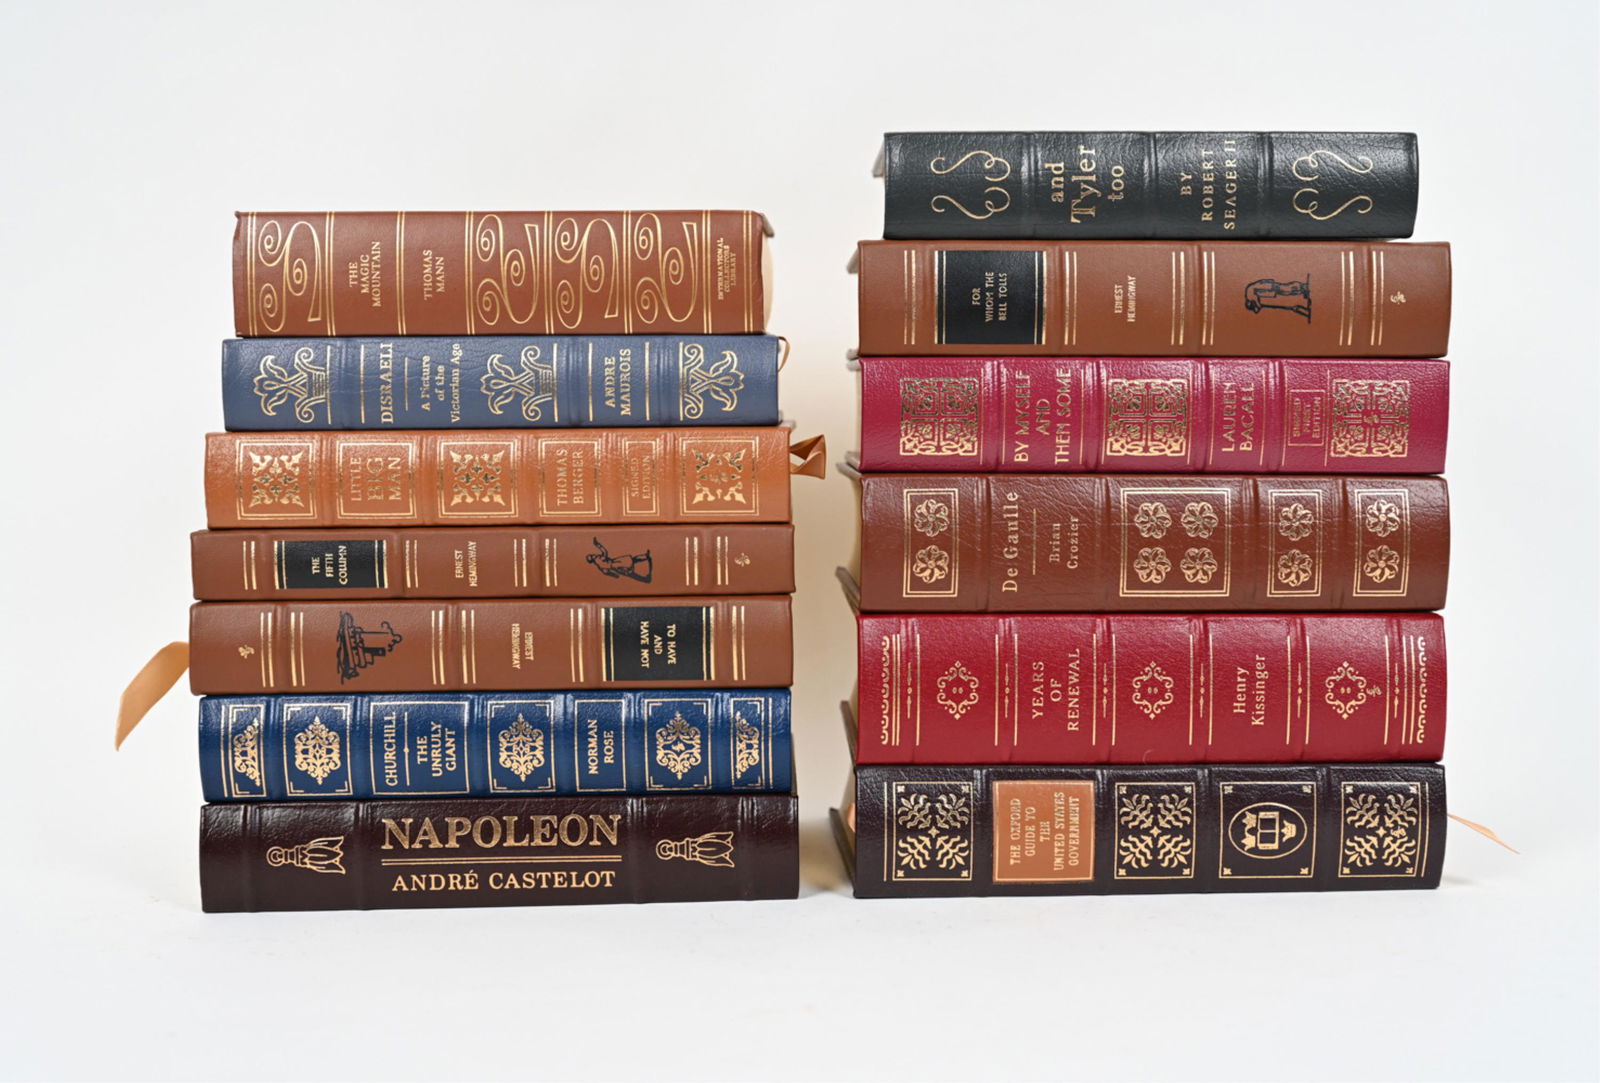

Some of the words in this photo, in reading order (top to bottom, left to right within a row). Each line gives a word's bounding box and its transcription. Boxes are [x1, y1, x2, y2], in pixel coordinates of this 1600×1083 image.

[1224, 139, 1236, 152] II
[1044, 162, 1065, 203] and
[1070, 145, 1101, 224] Tyler
[1108, 165, 1125, 201] too
[1180, 172, 1192, 196] BY
[1201, 149, 1214, 222] ROBERT
[1224, 157, 1237, 230] SEAGER
[349, 262, 358, 287] THE
[360, 254, 370, 293] MAGIC
[371, 241, 382, 307] MOUNTAIN
[423, 249, 433, 300] THOMAS
[435, 256, 445, 293] MANN
[716, 237, 724, 300] INTERNATIONAL
[985, 271, 995, 287] THE
[998, 272, 1008, 297] TOLLS
[971, 287, 981, 306] FOR
[985, 289, 995, 323] WHOM
[998, 301, 1008, 321] BELL
[451, 343, 462, 363] Age
[380, 343, 394, 424] DISRAELI
[420, 355, 431, 398] Picture
[435, 365, 446, 385] the
[435, 388, 445, 402] of
[604, 356, 616, 408] ANDRE
[620, 348, 632, 416] MAUROIS
[1055, 367, 1072, 417] SOME
[421, 402, 431, 411] A
[450, 369, 461, 423] Victorian
[1014, 370, 1030, 437] MYSELF
[1035, 398, 1051, 436] AND
[1221, 382, 1237, 452] LAUREN
[1239, 383, 1255, 452] BACALL
[1312, 396, 1321, 439] EDITION
[1014, 441, 1029, 463] BY
[1055, 420, 1071, 465] THEN
[351, 457, 362, 501] LITTLE
[367, 458, 384, 501] BIG
[388, 457, 402, 501] MAN
[556, 448, 569, 506] THOMAS
[572, 450, 584, 504] BERGER
[631, 457, 639, 498] SIGNED
[642, 455, 651, 500] EDITION
[1002, 491, 1019, 560] Gaulle
[1049, 522, 1060, 563] Brian
[1067, 516, 1079, 569] Crozier
[311, 556, 321, 574] THE
[325, 553, 334, 578] FIFTH
[338, 545, 348, 585] COLUMN
[455, 549, 465, 578] ERNEST
[468, 541, 478, 587] HEMINGWAY
[1002, 566, 1019, 593] De
[640, 621, 650, 646] HAVE
[653, 635, 663, 655] AND
[667, 624, 676, 638] TO
[640, 649, 650, 669] NOT
[667, 640, 676, 665] HAVE
[1032, 661, 1044, 719] YEARS
[1050, 677, 1062, 702] OF
[1068, 648, 1080, 732] RENEWAL
[1233, 666, 1250, 713] Henry
[1251, 654, 1269, 726] Kissinger
[383, 711, 398, 787] CHURCHILL
[416, 736, 427, 764] THE
[432, 721, 443, 777] UNRULY
[445, 728, 457, 771] GIANT
[587, 719, 599, 775] NORMAN
[603, 730, 615, 764] ROSE
[1024, 806, 1036, 822] TO
[1053, 791, 1065, 830] STATES
[1068, 795, 1080, 866] GOVERNMENT
[381, 814, 622, 850] NAPOLEON
[1024, 825, 1036, 857] GUIDE
[1039, 821, 1050, 842] THE
[1009, 844, 1021, 866] THE
[1053, 833, 1065, 871] UNITED
[392, 870, 479, 891] ANDRÉ
[488, 871, 616, 889] CASTELOT
